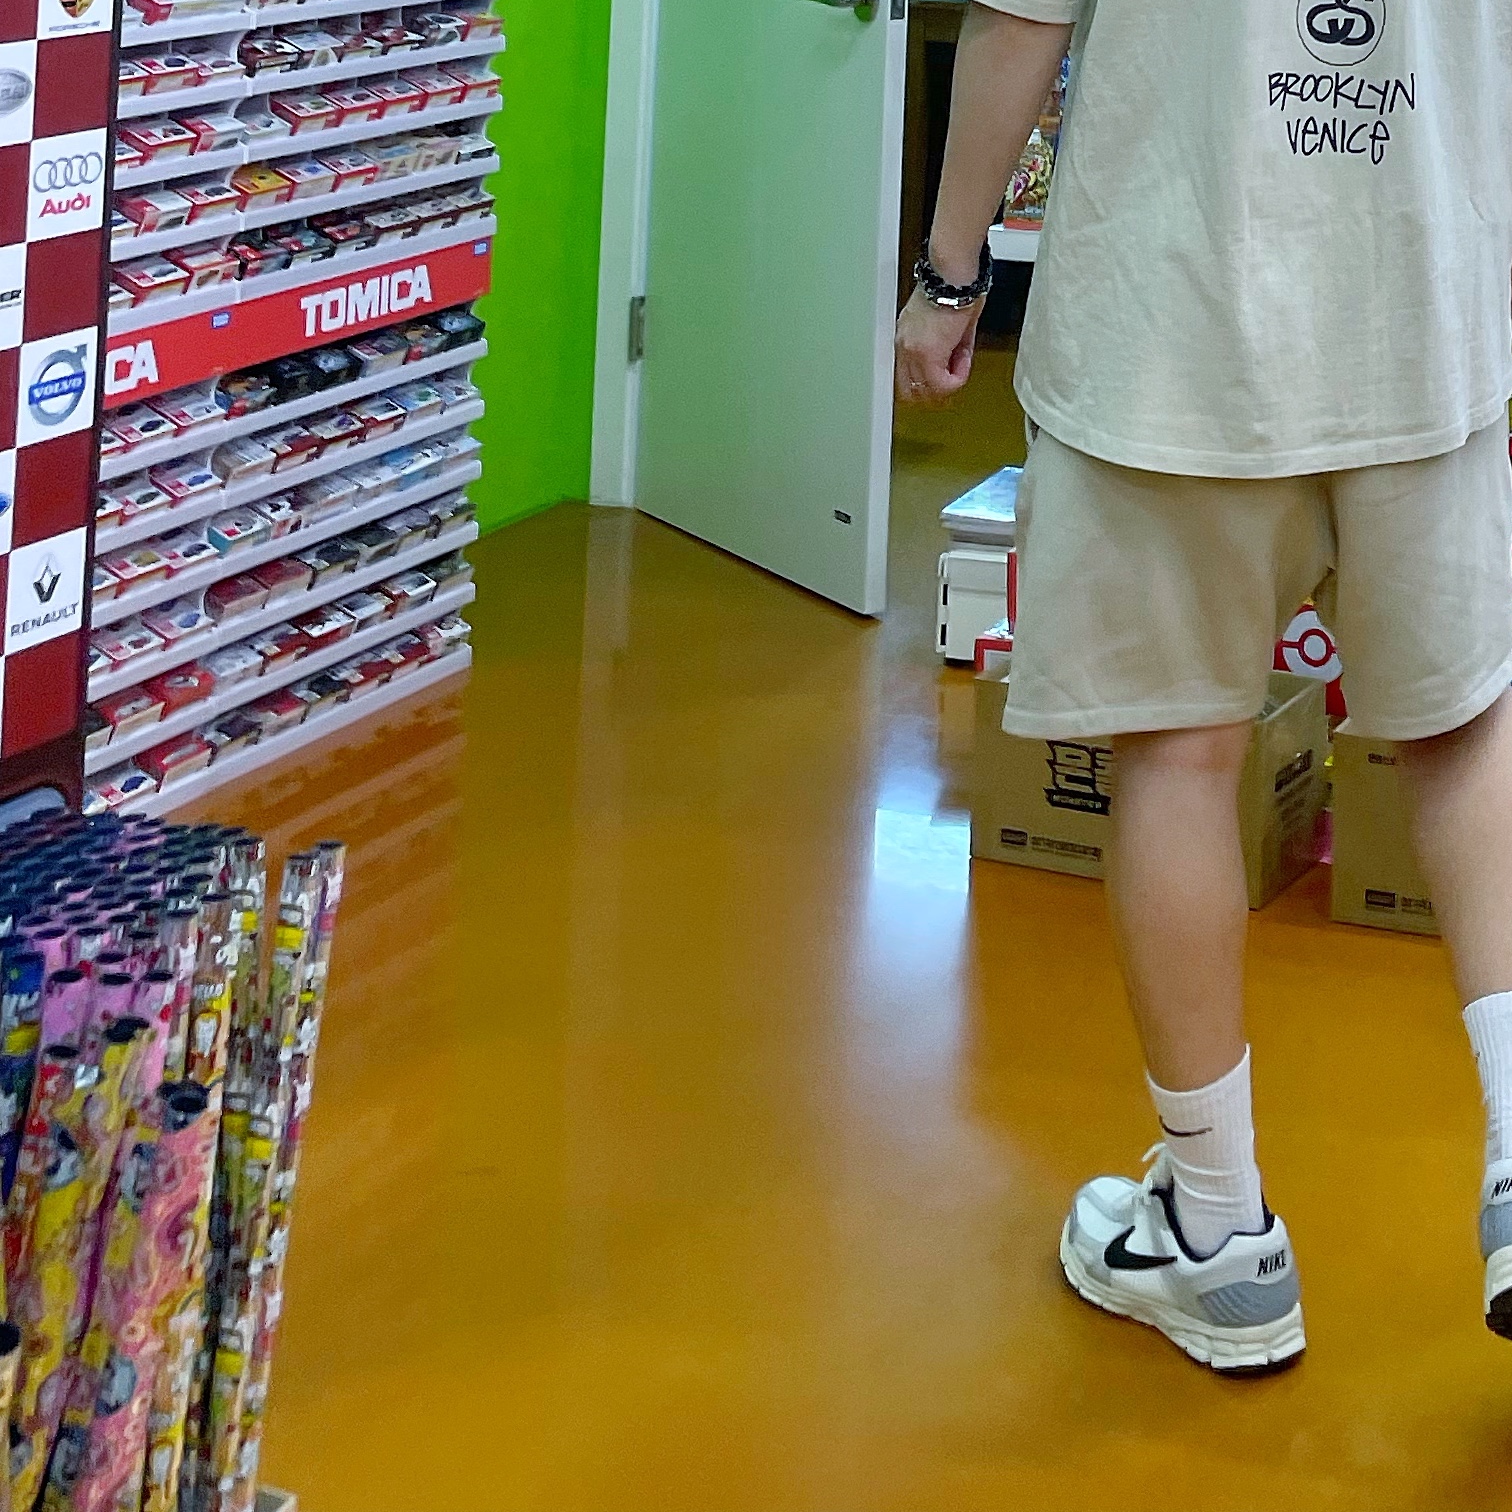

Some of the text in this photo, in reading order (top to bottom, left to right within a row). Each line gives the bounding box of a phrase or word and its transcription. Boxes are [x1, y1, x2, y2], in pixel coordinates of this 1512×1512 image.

[1268, 72, 1415, 115] BROOKLYN
[38, 192, 92, 218] Audi
[300, 263, 432, 339] TOMICA
[31, 376, 84, 402] VOLVO
[10, 601, 79, 637] RENAULT
[1256, 1246, 1288, 1278] NIKE
